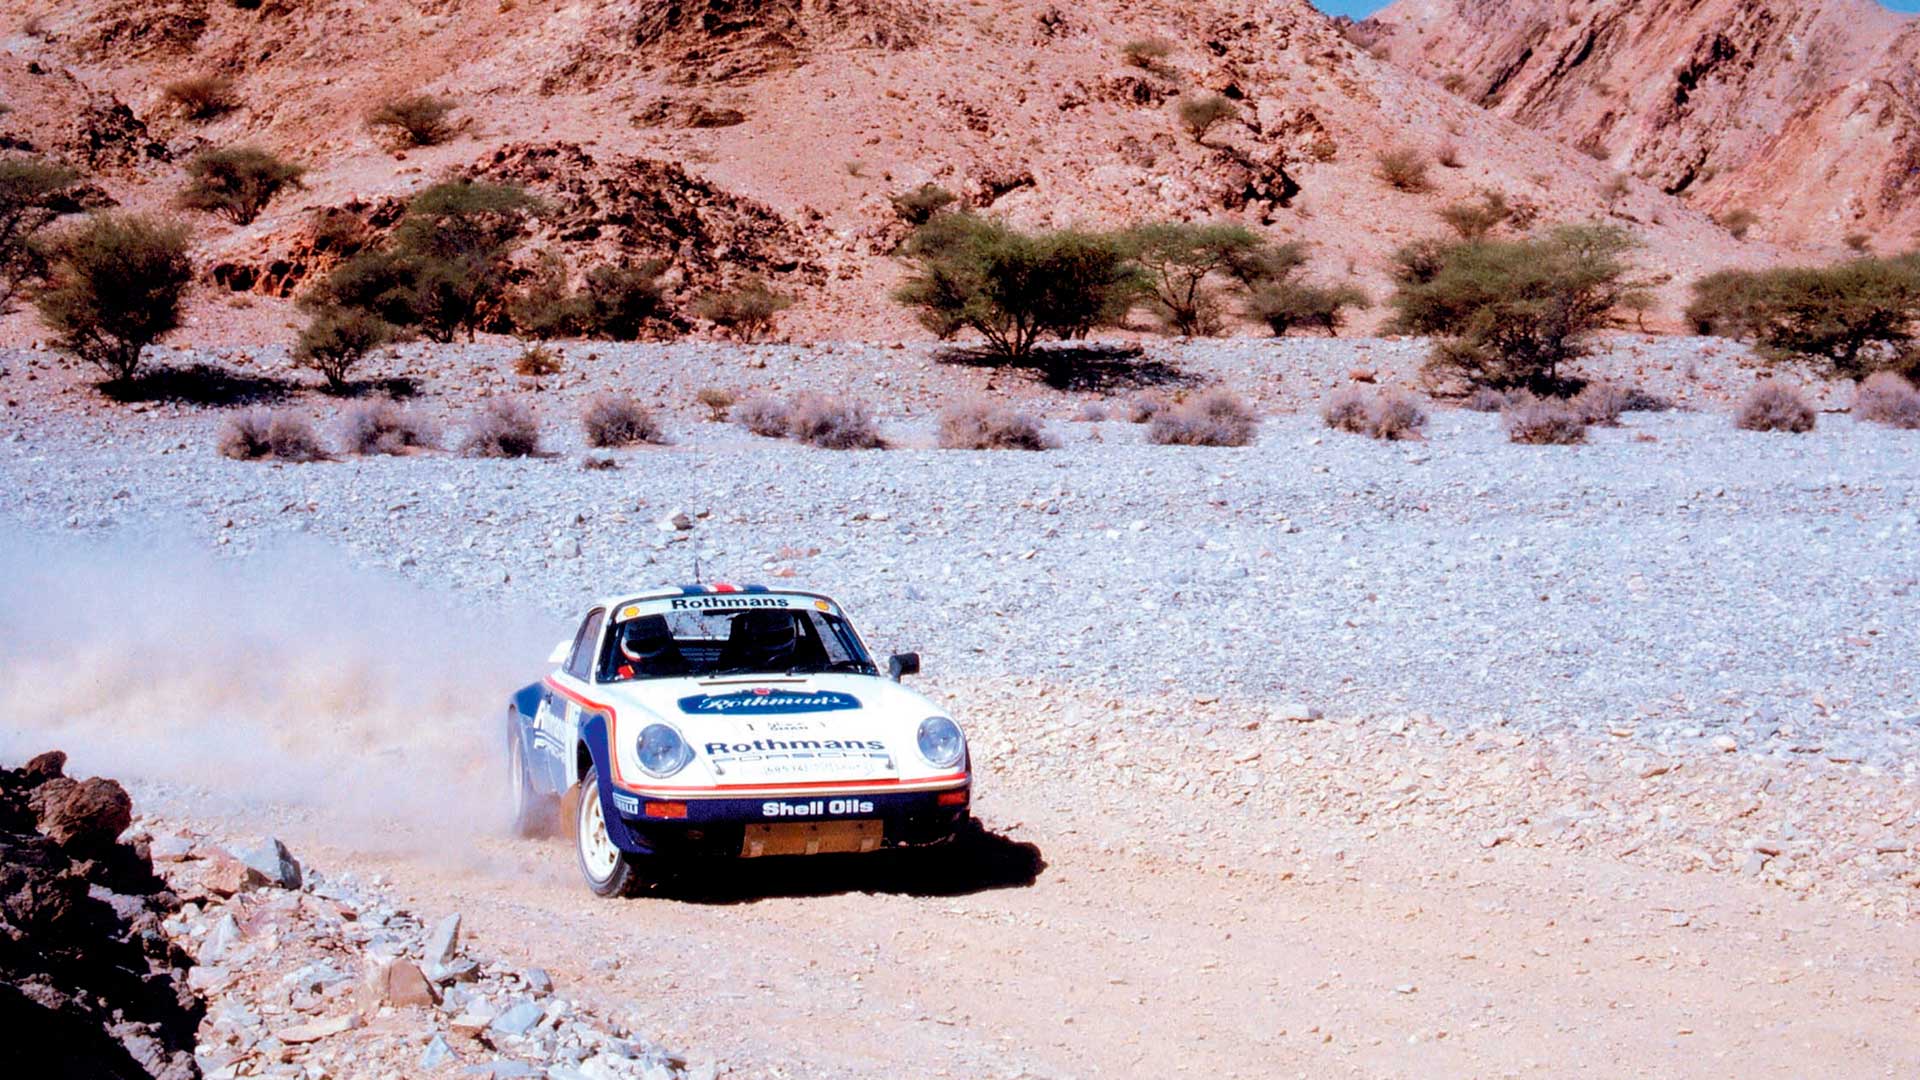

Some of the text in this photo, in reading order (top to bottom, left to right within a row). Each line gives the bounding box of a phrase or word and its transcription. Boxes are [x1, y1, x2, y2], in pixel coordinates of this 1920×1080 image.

[672, 597, 790, 609] Rothmans
[699, 696, 848, 711] Rothmans
[705, 739, 885, 755] Rothmans
[762, 799, 874, 816] Shell Oils
